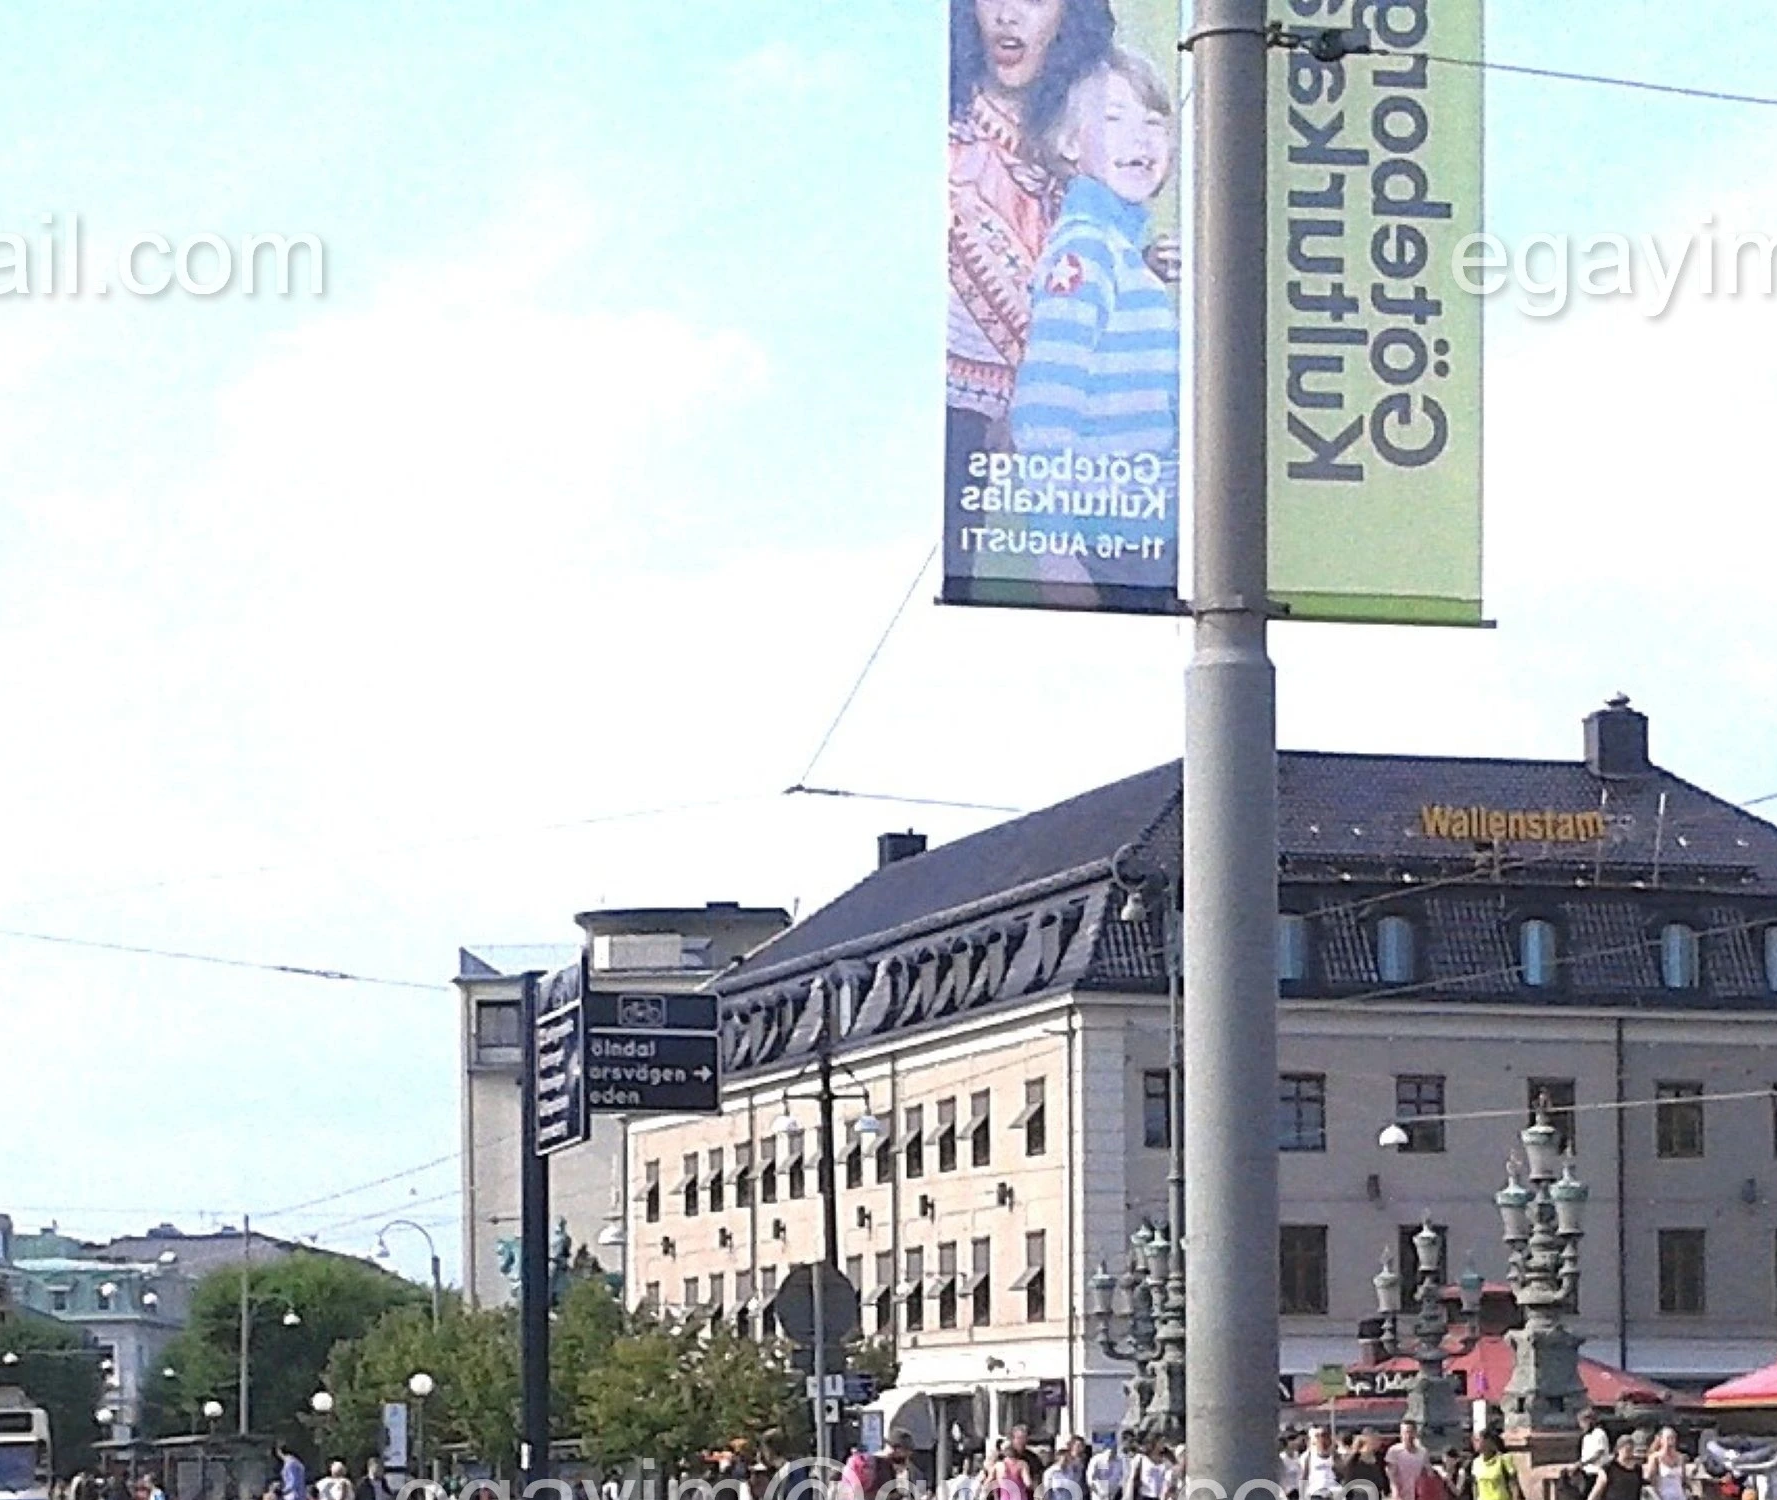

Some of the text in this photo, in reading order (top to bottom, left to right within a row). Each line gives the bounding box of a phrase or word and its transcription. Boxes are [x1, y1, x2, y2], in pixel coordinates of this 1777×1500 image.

[1422, 804, 1603, 841] Wallenstam
[590, 1039, 656, 1057] ölndal
[589, 1065, 687, 1086] orsvägen
[589, 1084, 641, 1105] eden
